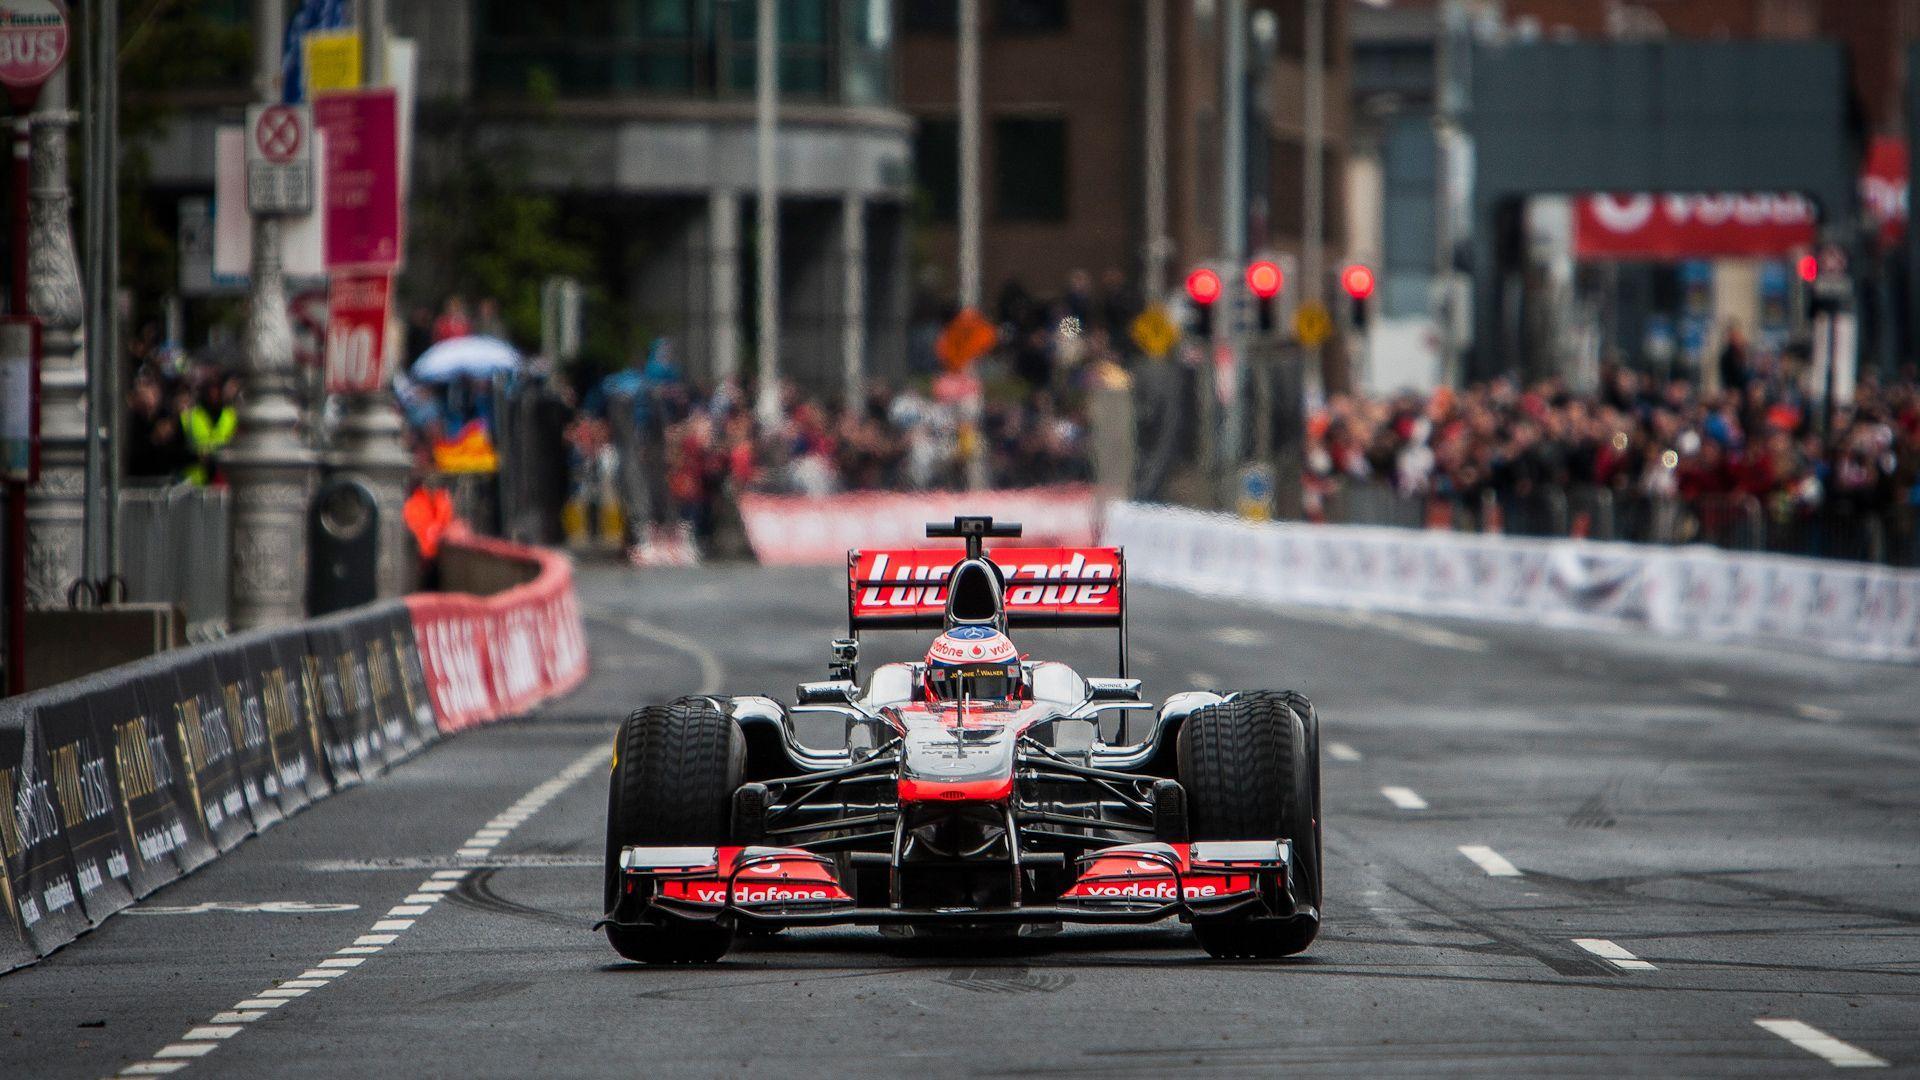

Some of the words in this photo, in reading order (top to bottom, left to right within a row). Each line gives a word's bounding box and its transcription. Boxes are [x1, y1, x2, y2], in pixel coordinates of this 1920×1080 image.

[860, 552, 1114, 607] Lucade
[950, 671, 975, 679] JONNIE
[980, 669, 1004, 677] WALKER
[697, 886, 827, 903] vodafone
[1086, 882, 1217, 898] vodafone
